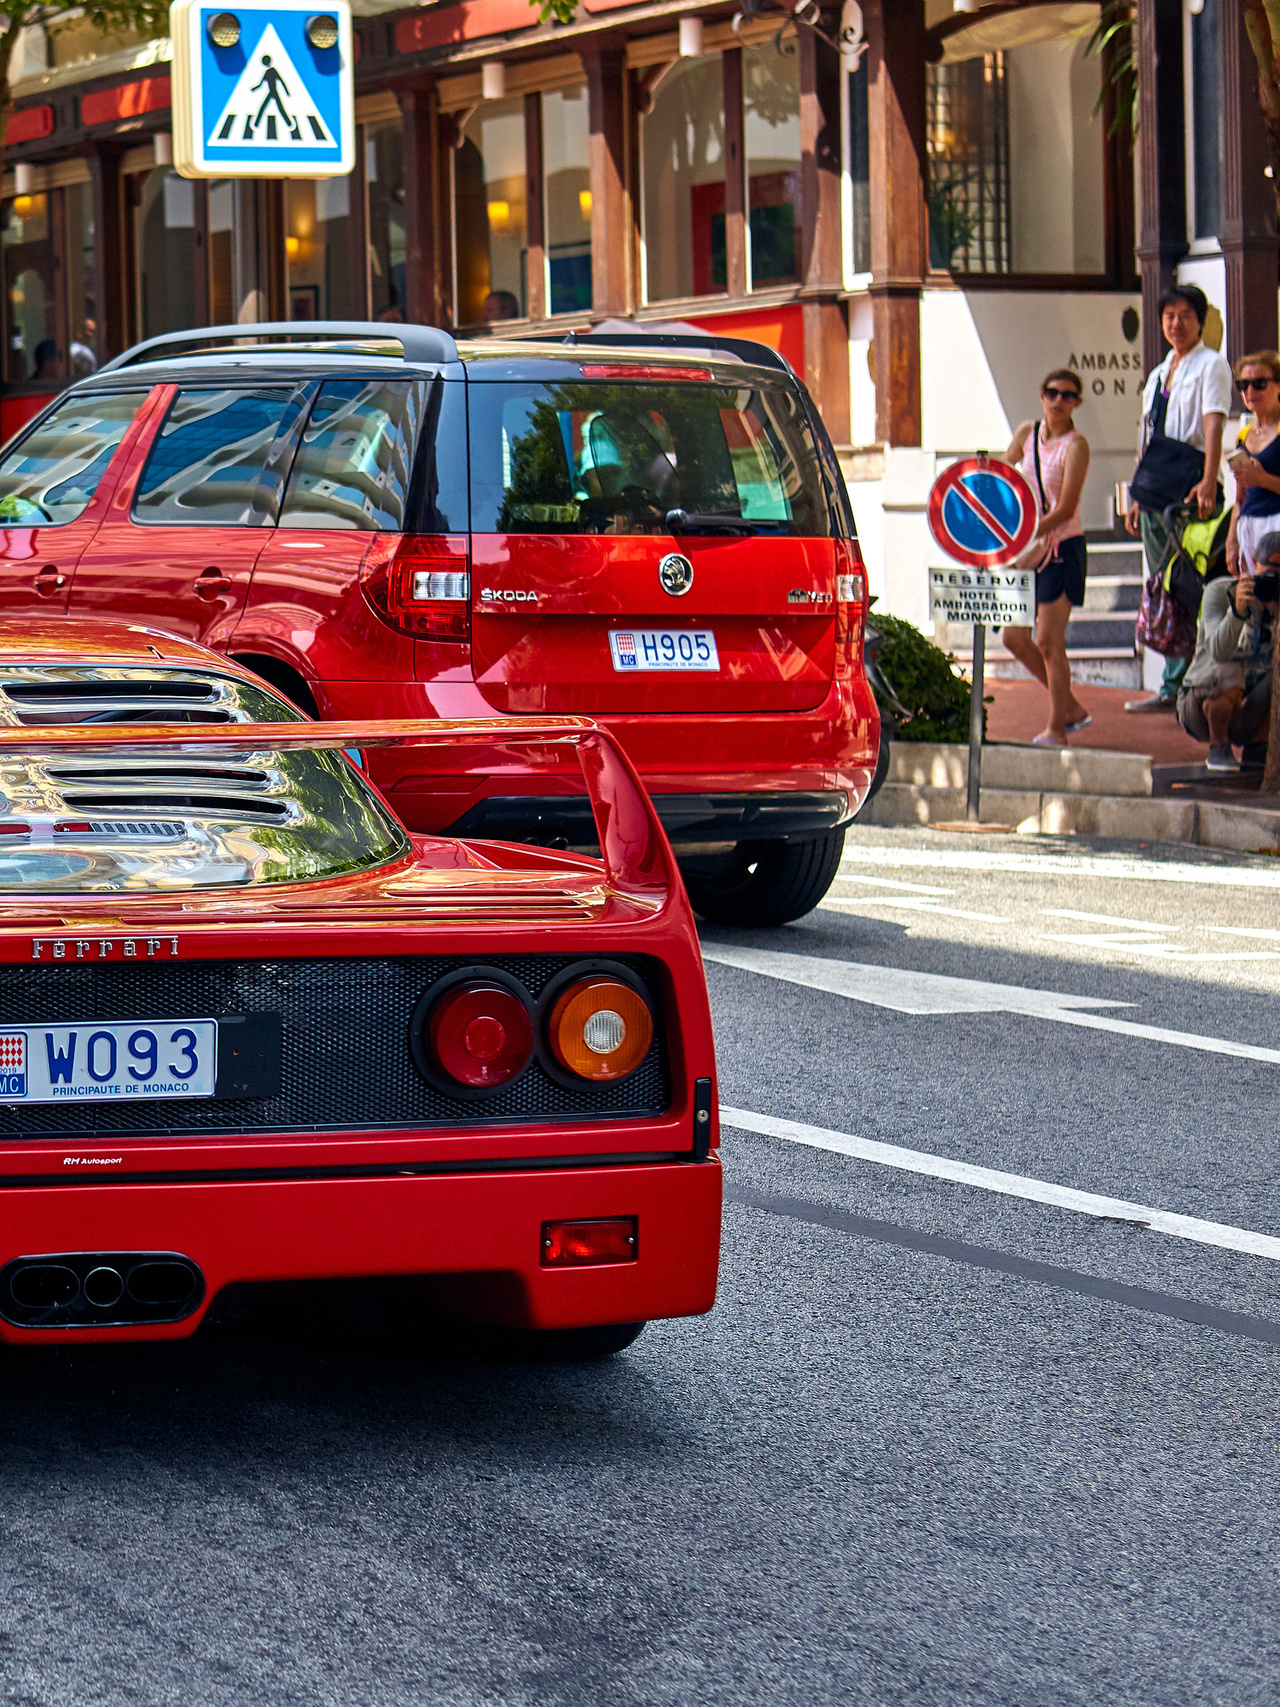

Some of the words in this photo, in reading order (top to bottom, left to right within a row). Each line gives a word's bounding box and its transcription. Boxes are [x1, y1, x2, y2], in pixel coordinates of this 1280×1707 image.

[1068, 352, 1141, 370] AMBASS
[960, 591, 998, 600] HOTEL
[934, 599, 1027, 612] AMBASSADOR
[948, 611, 1011, 622] MONACO
[641, 634, 710, 661] H905
[622, 655, 635, 666] MC
[32, 935, 178, 958] Ferrari
[45, 1028, 199, 1084] W093
[53, 1085, 121, 1096] PRINCIPAUTE
[125, 1083, 139, 1093] DE
[143, 1082, 189, 1093] MONACO
[63, 1157, 80, 1165] RM
[81, 1157, 122, 1165] Autosport
